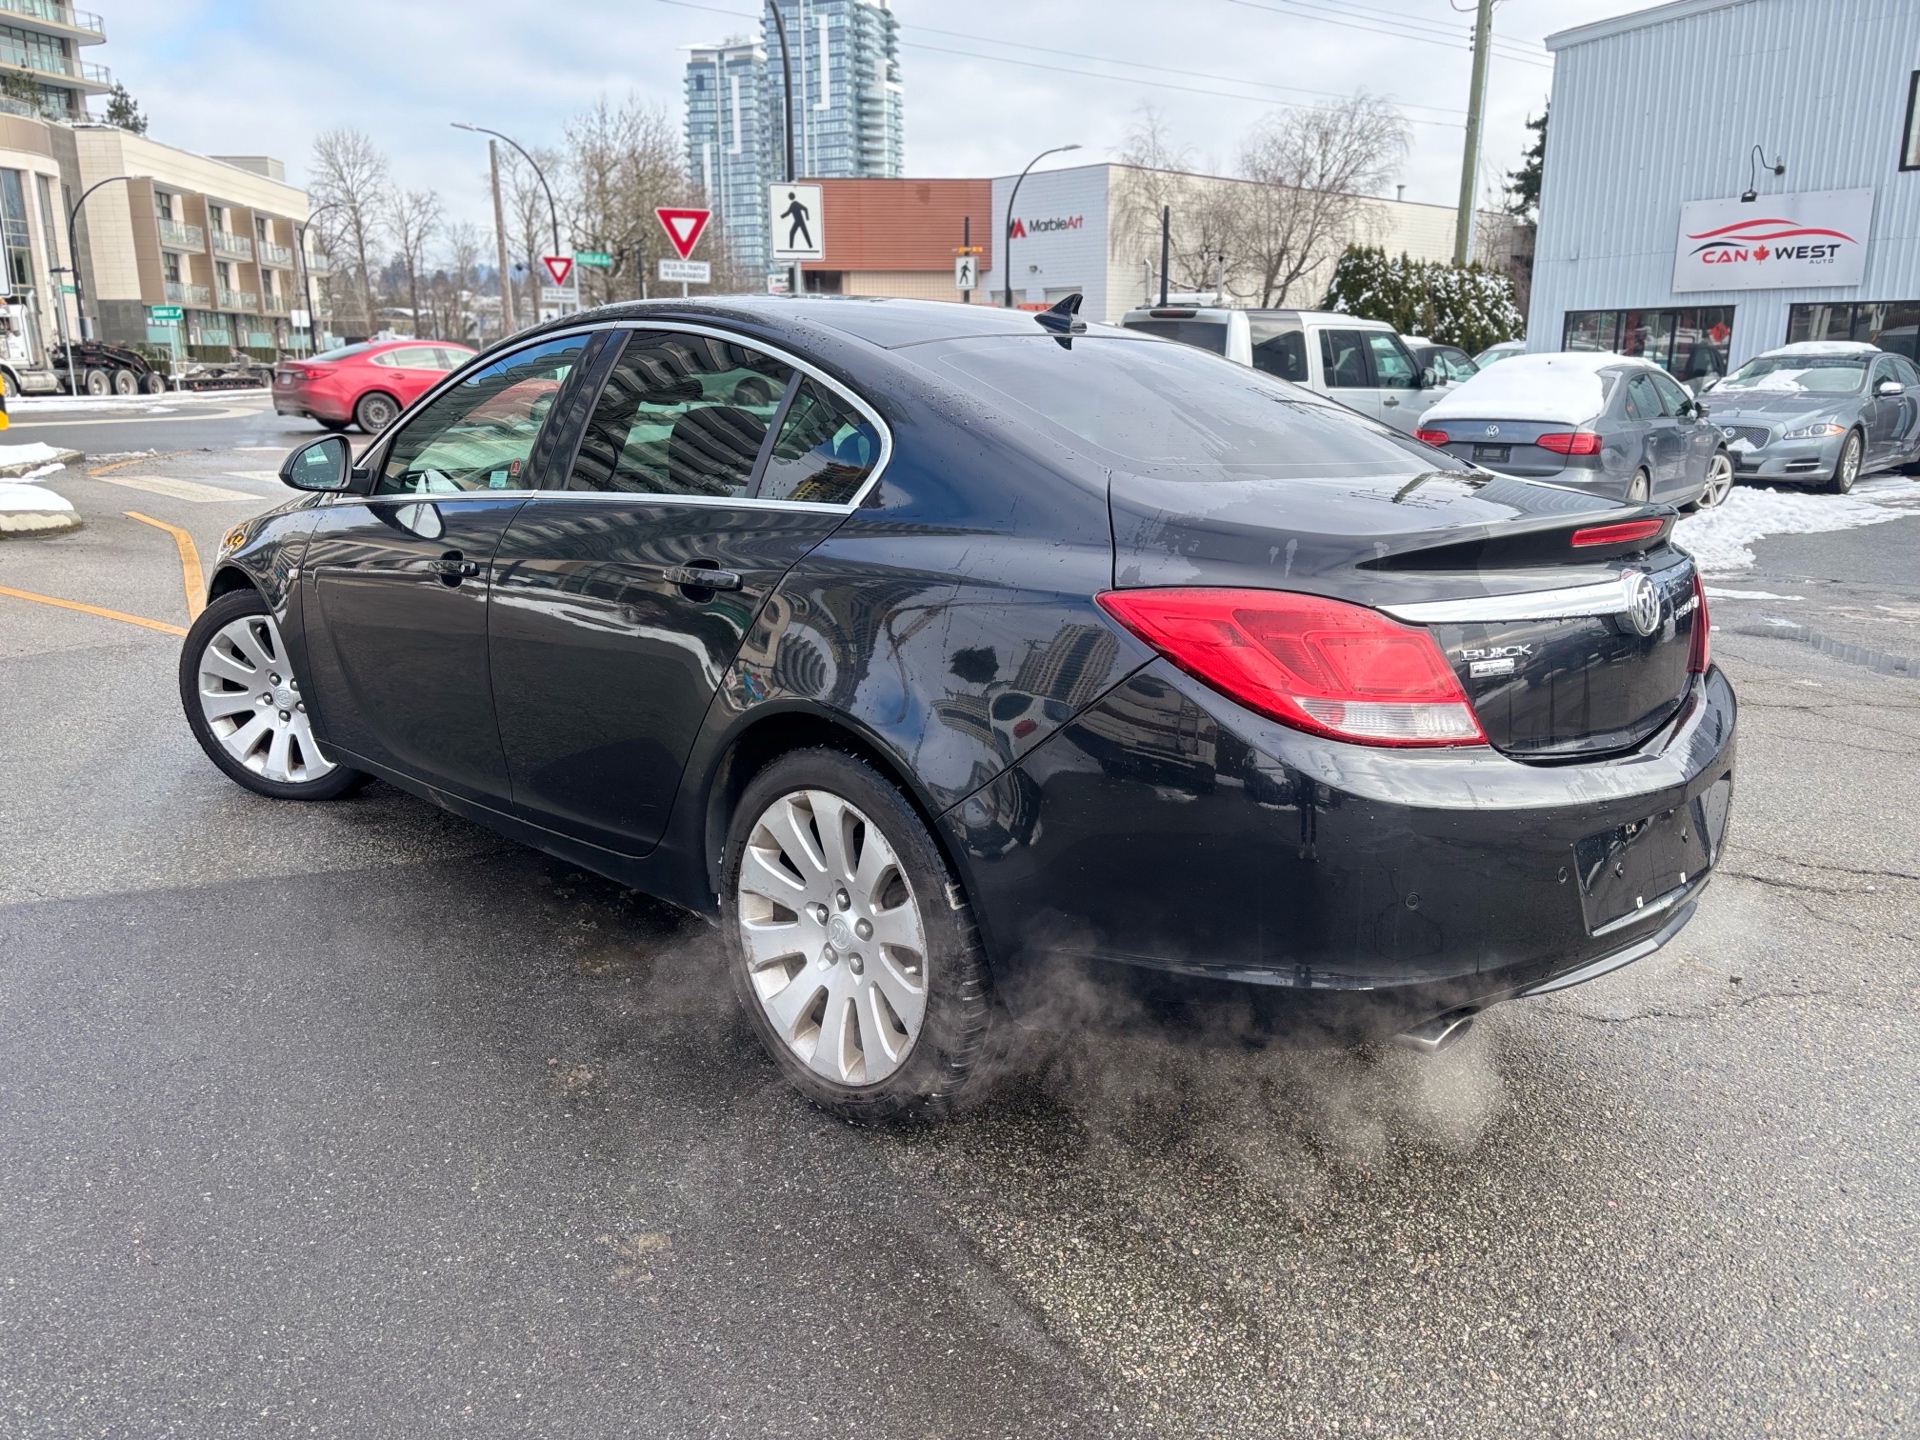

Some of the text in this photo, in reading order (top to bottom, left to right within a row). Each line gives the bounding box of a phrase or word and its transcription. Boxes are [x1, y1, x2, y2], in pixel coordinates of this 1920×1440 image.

[1029, 215, 1083, 233] MarbleArt
[1702, 244, 1842, 264] CAN WEST
[1460, 644, 1533, 661] BUICK
